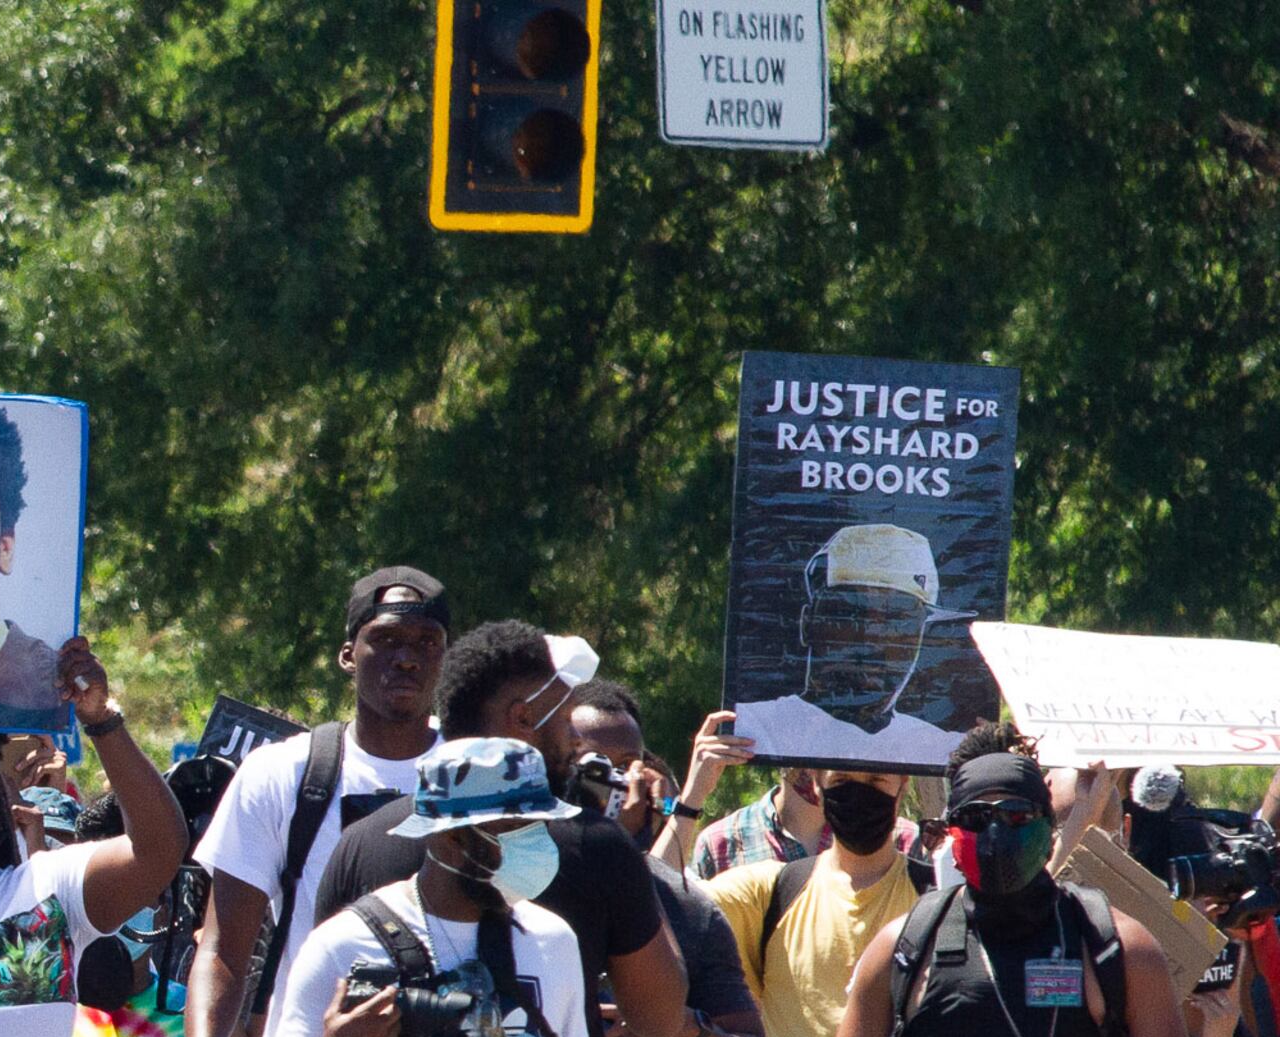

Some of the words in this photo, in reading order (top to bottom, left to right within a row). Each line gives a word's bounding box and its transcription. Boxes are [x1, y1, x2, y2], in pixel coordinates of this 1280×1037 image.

[679, 10, 703, 36] ON
[713, 11, 804, 42] FLASHING
[700, 54, 785, 85] YELLOW
[705, 99, 782, 129] ARROW
[767, 379, 946, 421] JUSTICE
[956, 398, 998, 418] FOR
[777, 422, 979, 460] RAYSHARD
[801, 460, 951, 497] BROOKS
